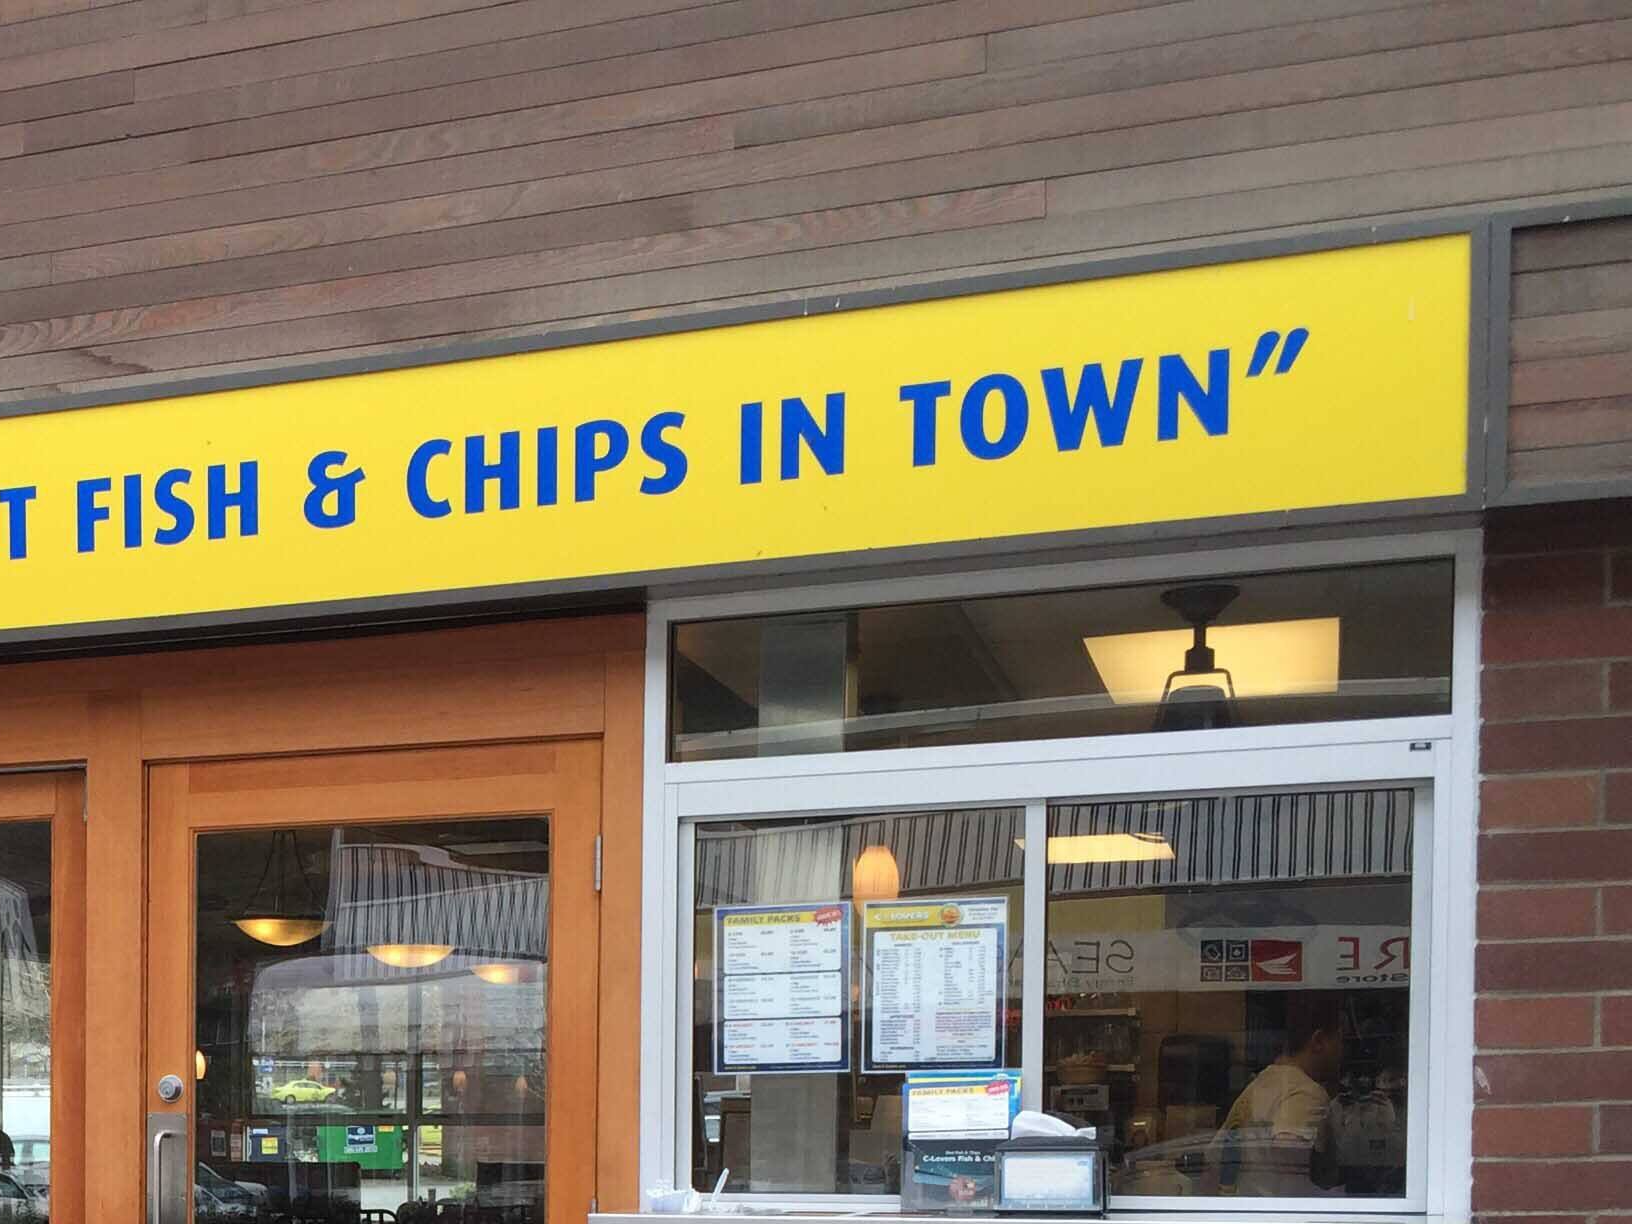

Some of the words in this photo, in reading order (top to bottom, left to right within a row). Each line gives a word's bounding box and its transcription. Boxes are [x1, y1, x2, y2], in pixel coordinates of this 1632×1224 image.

[76, 460, 259, 554] FISH
[303, 450, 365, 529] &
[406, 411, 689, 519] CHIPS
[740, 392, 846, 485] IN
[727, 914, 765, 926] FAMILY
[767, 912, 801, 924] PACKS
[889, 930, 945, 942] TAKE-OUT
[947, 929, 981, 940] MENU
[922, 1154, 957, 1162] C-Lovers
[957, 1154, 974, 1162] Fish
